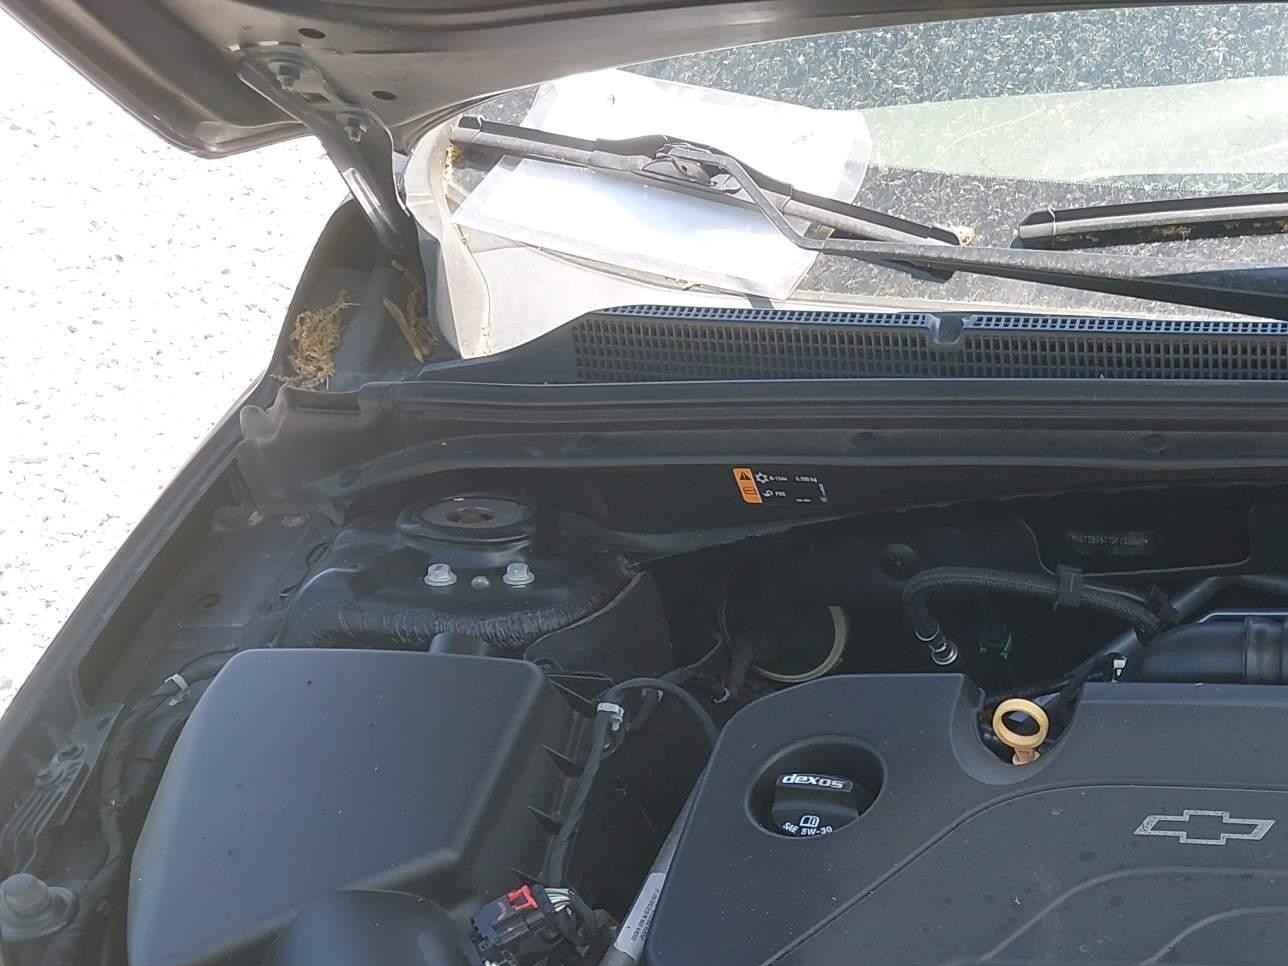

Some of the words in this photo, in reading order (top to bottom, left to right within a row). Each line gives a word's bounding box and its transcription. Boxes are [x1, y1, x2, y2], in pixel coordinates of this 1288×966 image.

[782, 774, 845, 788] dexos
[782, 822, 799, 834] SAE
[800, 826, 833, 836] 5W-30
